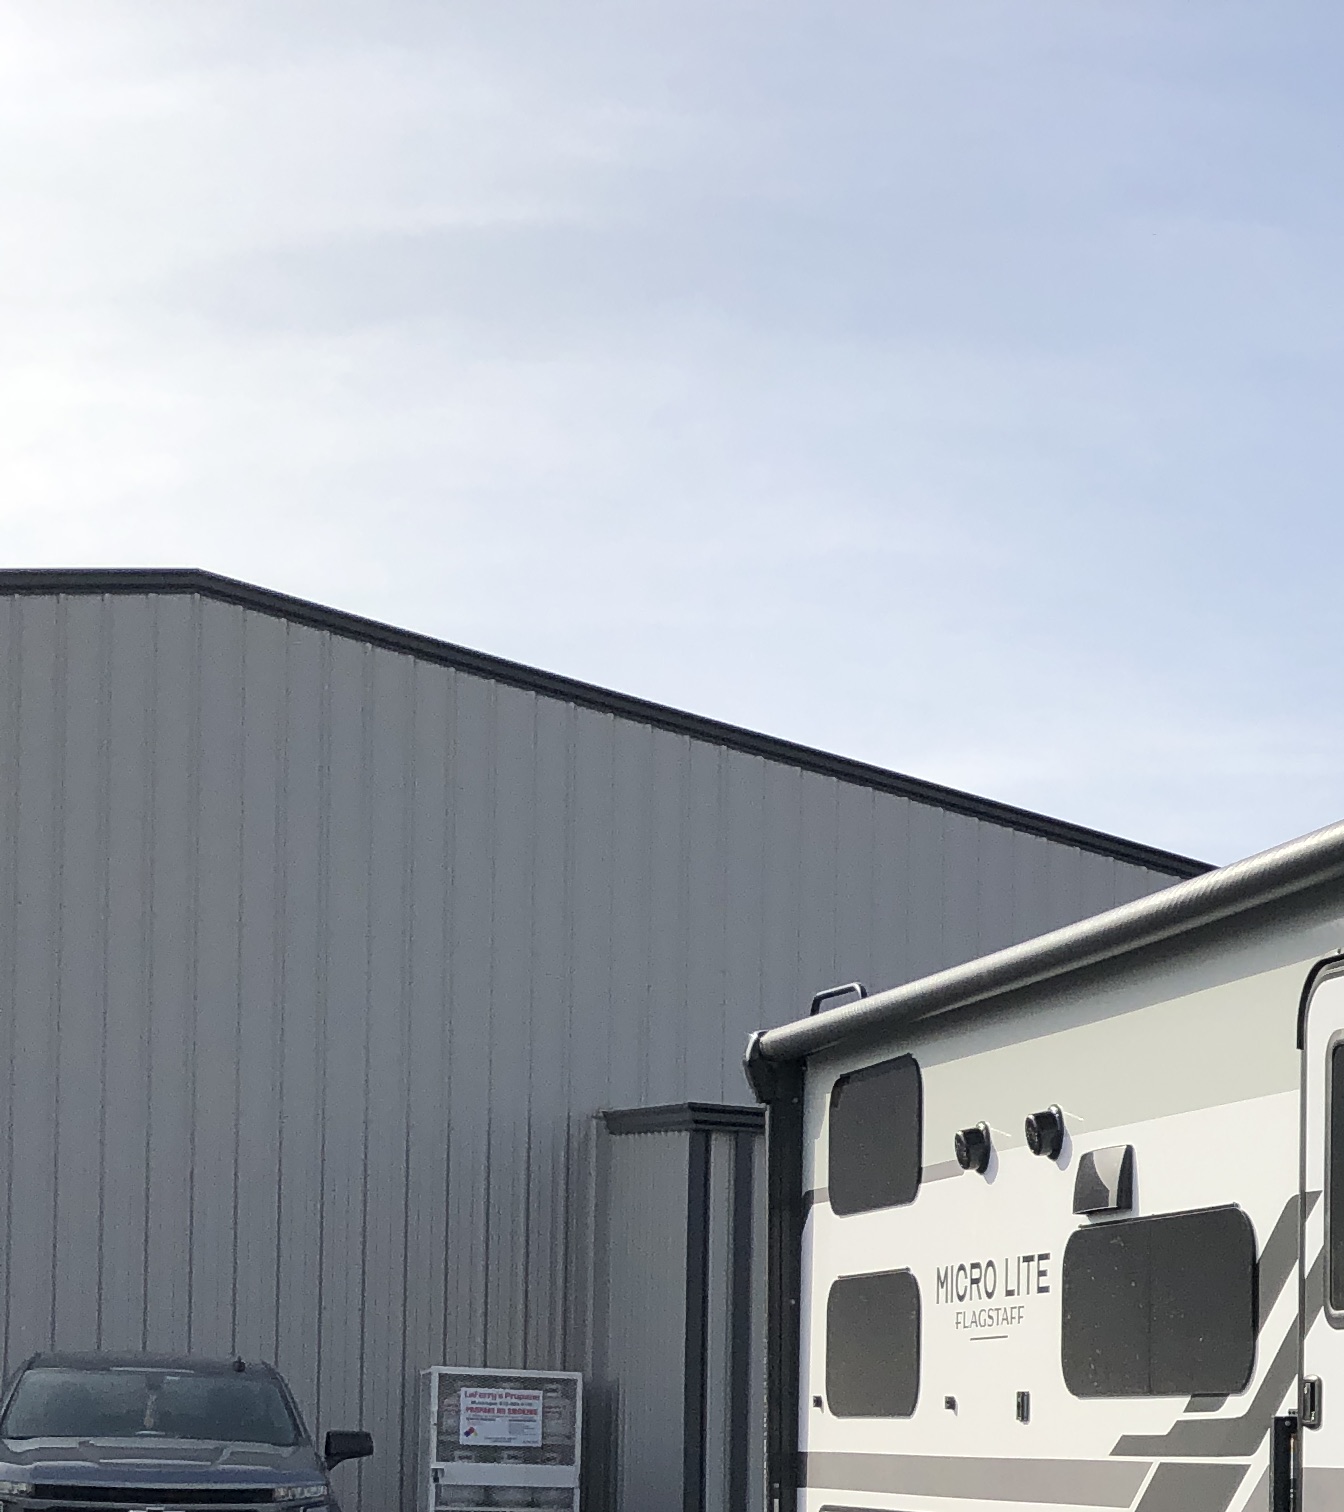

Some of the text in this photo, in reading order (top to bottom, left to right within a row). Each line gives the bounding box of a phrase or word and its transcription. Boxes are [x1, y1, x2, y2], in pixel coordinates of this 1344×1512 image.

[936, 1252, 1051, 1305] MICRO LITE
[955, 1305, 1025, 1330] FLAGSTAFF
